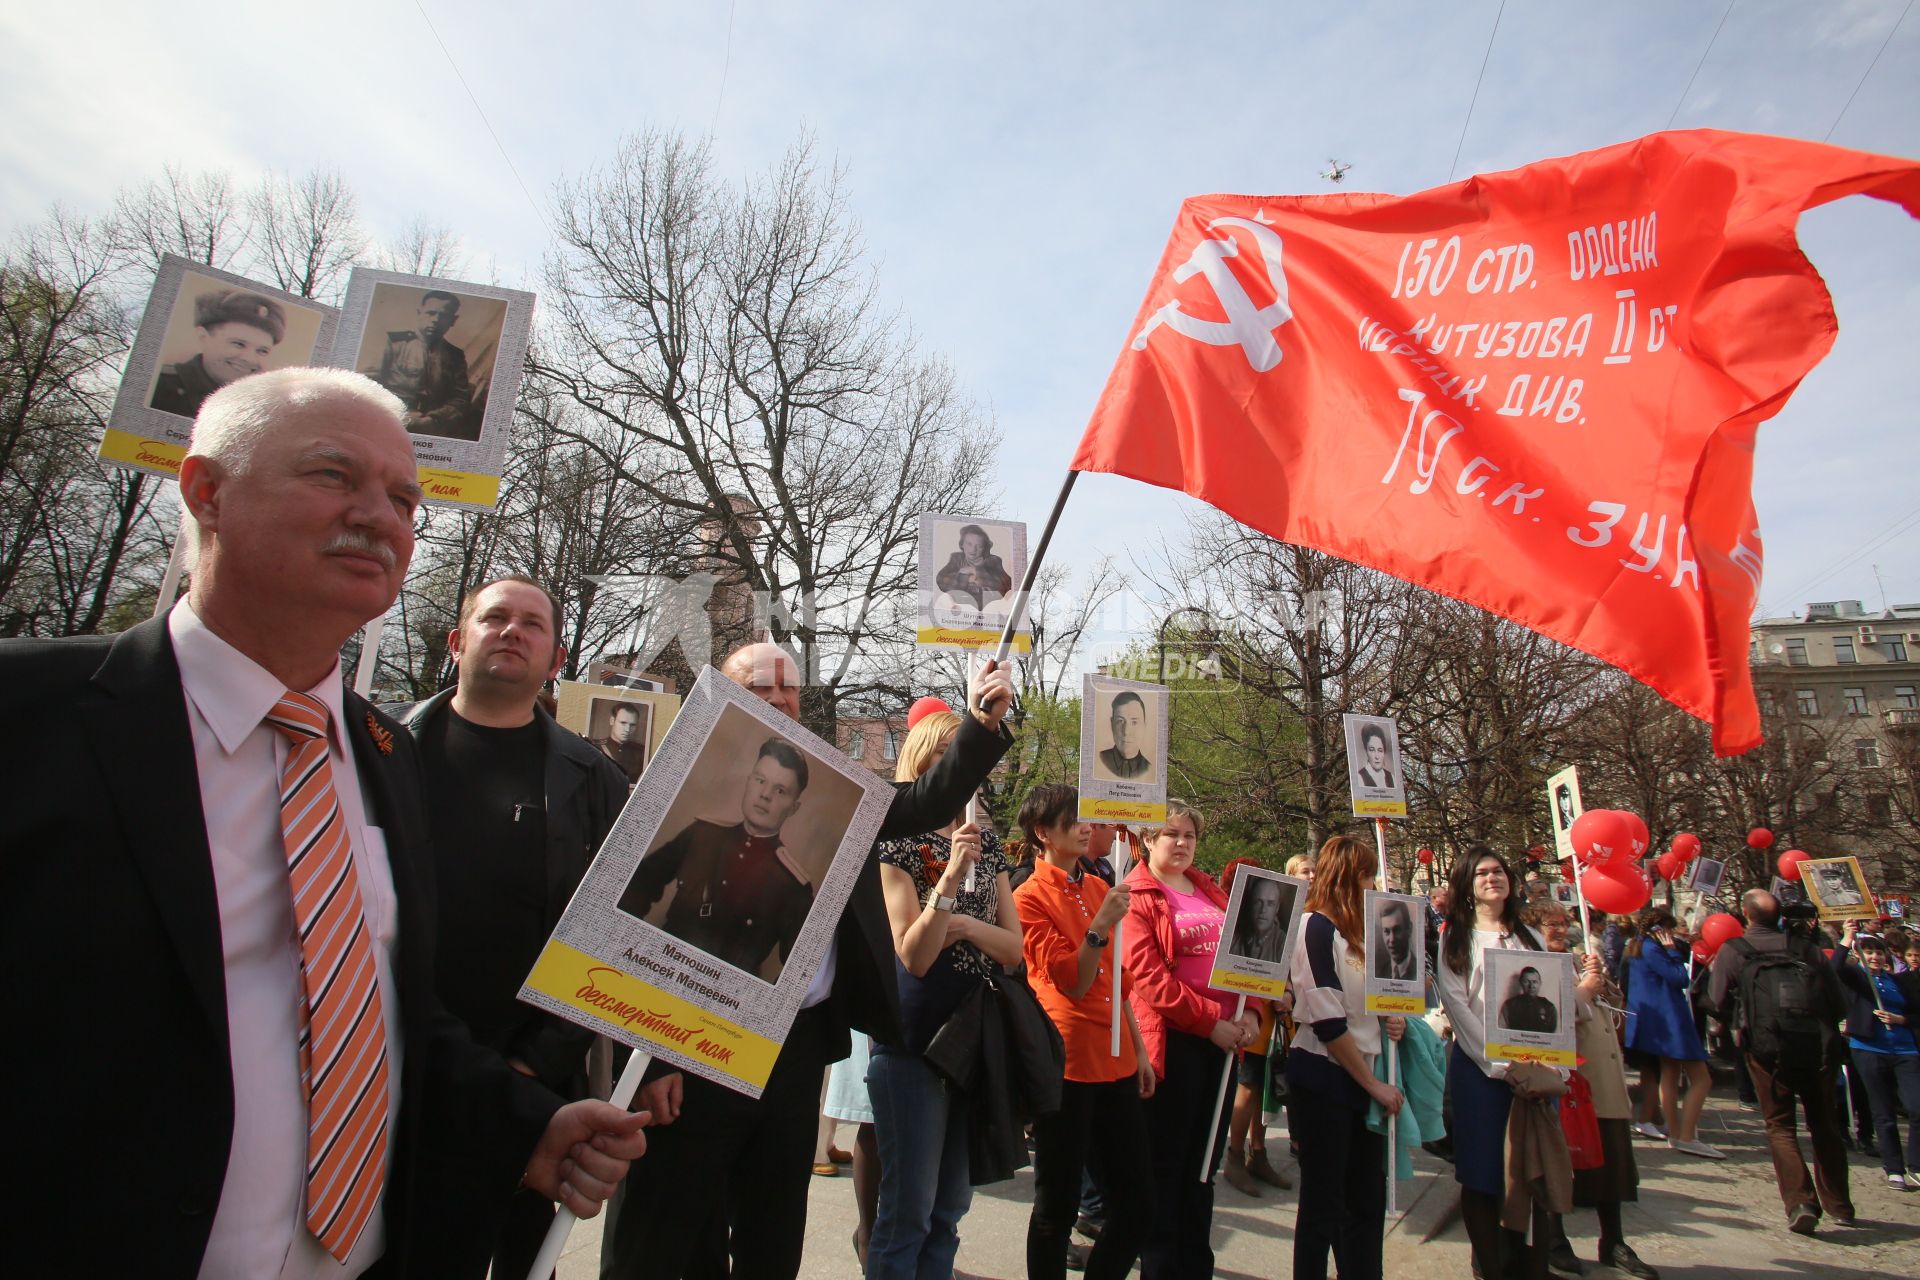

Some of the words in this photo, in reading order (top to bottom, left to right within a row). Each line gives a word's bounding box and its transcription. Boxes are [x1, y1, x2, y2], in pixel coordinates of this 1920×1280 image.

[1391, 235, 1461, 299] 150
[1466, 243, 1537, 294] СТР.
[1568, 211, 1659, 281] ОРДЕНА
[1404, 313, 1593, 358] КУТУЗОВА
[1496, 374, 1586, 425] ДИВ.
[622, 947, 674, 978] Алексей
[675, 974, 741, 1011] Матвеевич
[662, 943, 722, 980] Матюшин
[695, 1036, 736, 1065] полк
